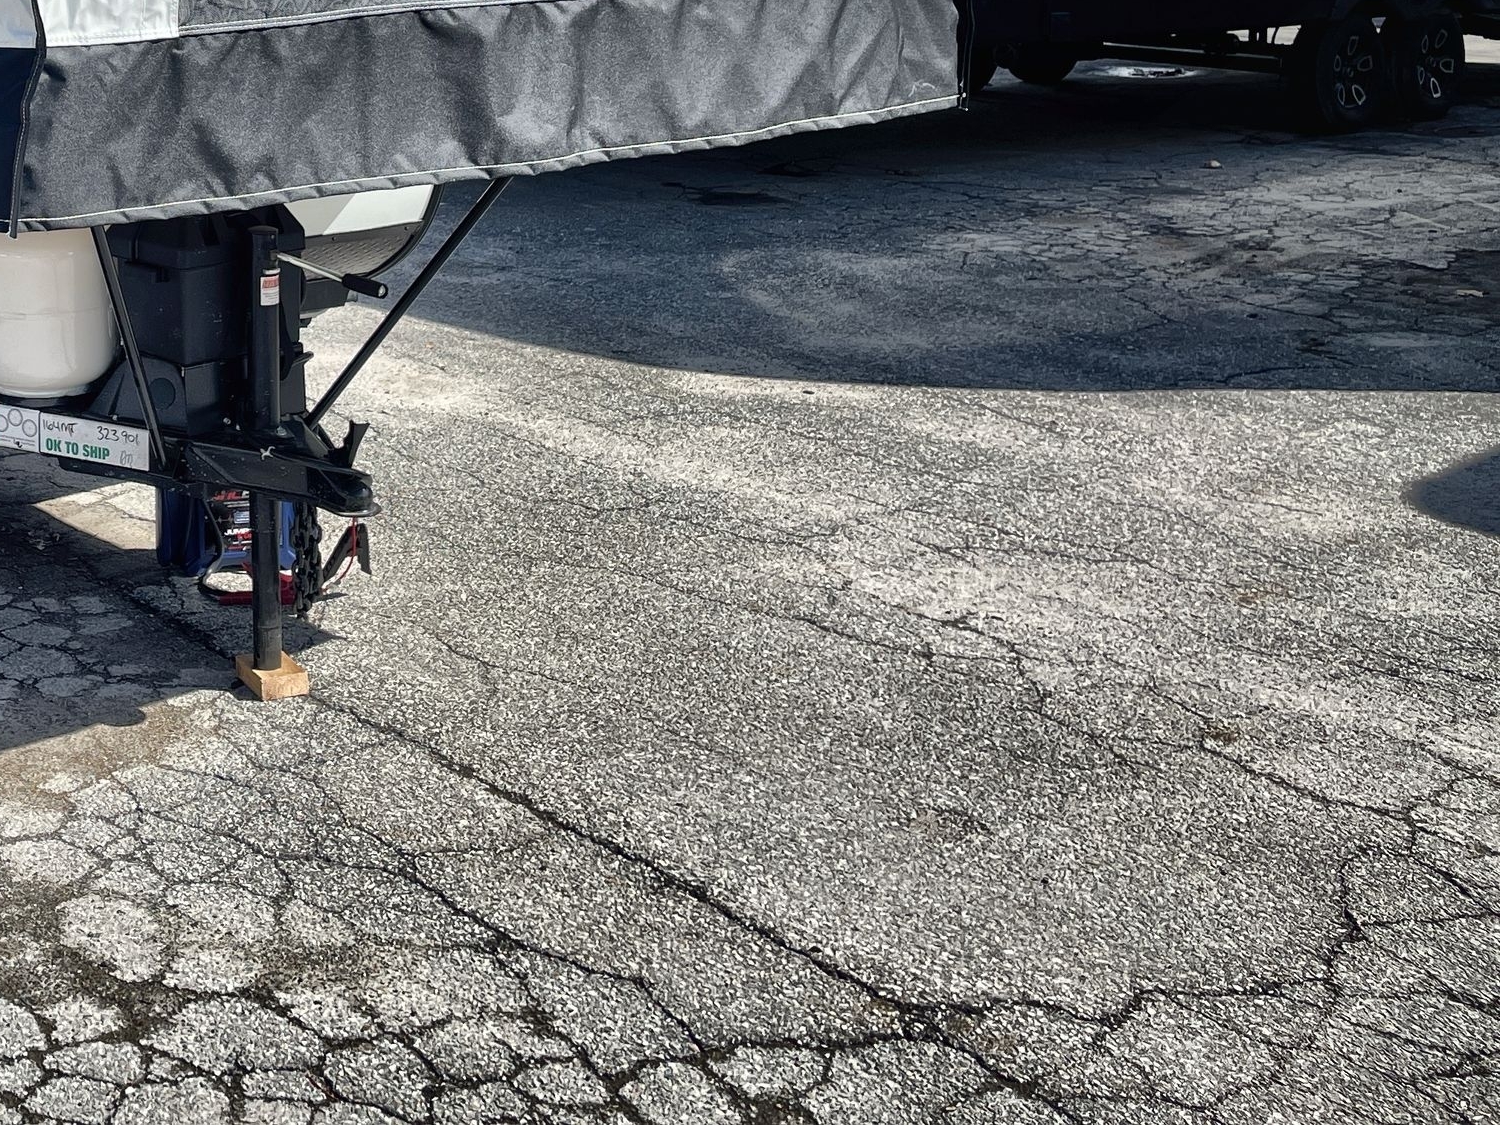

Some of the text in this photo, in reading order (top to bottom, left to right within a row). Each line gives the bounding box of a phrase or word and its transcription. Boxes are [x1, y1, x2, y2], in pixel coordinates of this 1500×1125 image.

[46, 437, 62, 453] OK
[64, 441, 79, 456] TO
[82, 444, 110, 460] SHIP
